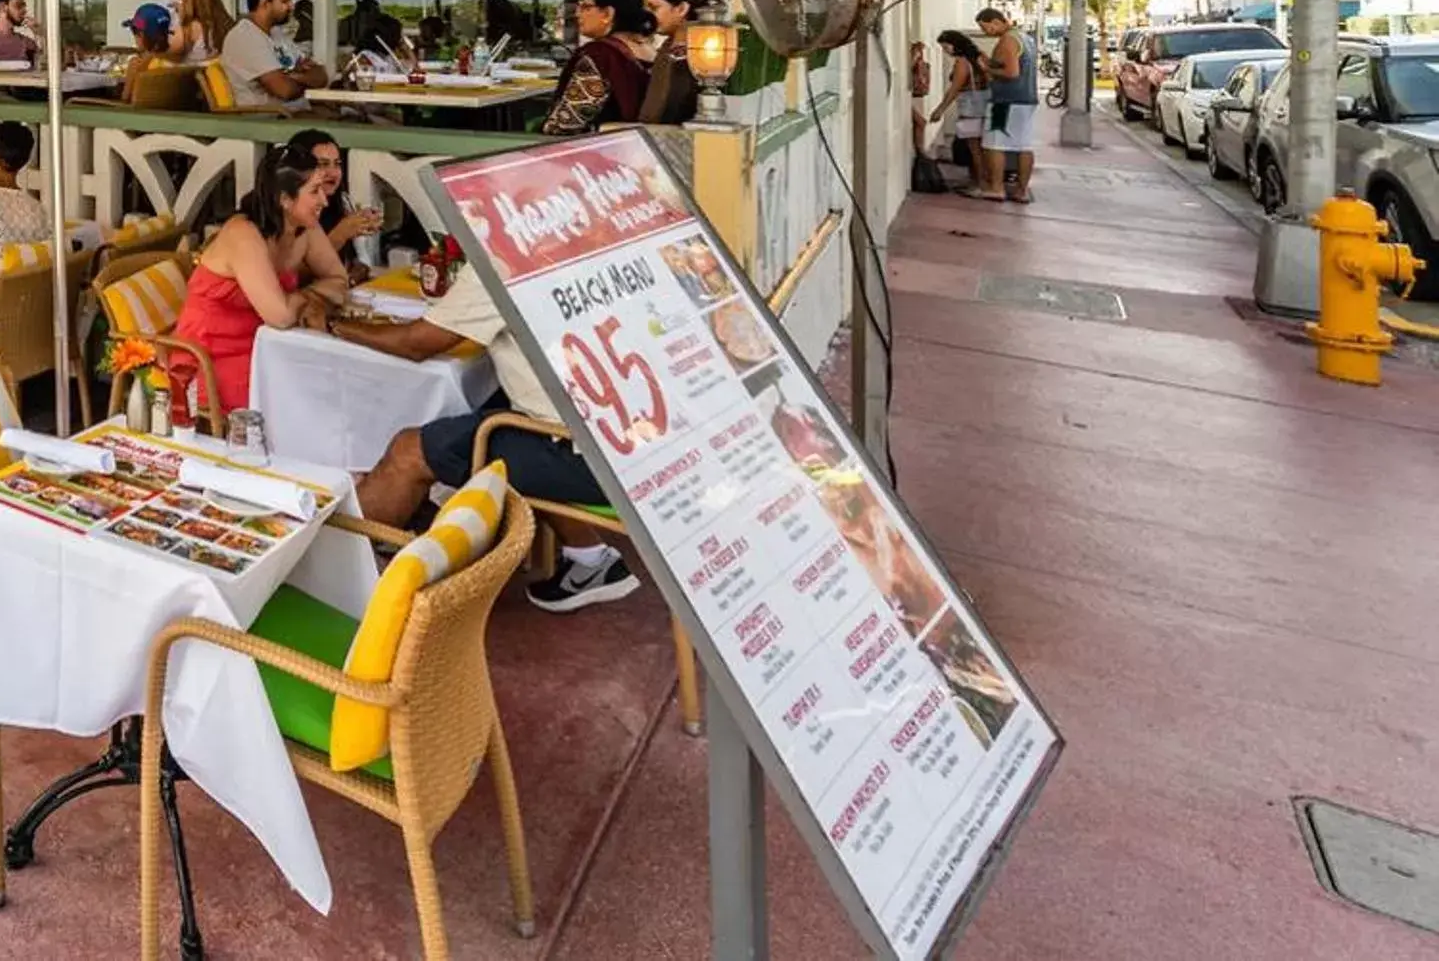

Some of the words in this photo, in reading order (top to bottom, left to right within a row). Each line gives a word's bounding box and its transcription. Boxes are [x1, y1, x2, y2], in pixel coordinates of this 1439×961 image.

[492, 185, 591, 257] Happy
[571, 162, 642, 218] Hour
[552, 278, 613, 321] BEACH
[608, 256, 656, 301] MENU
